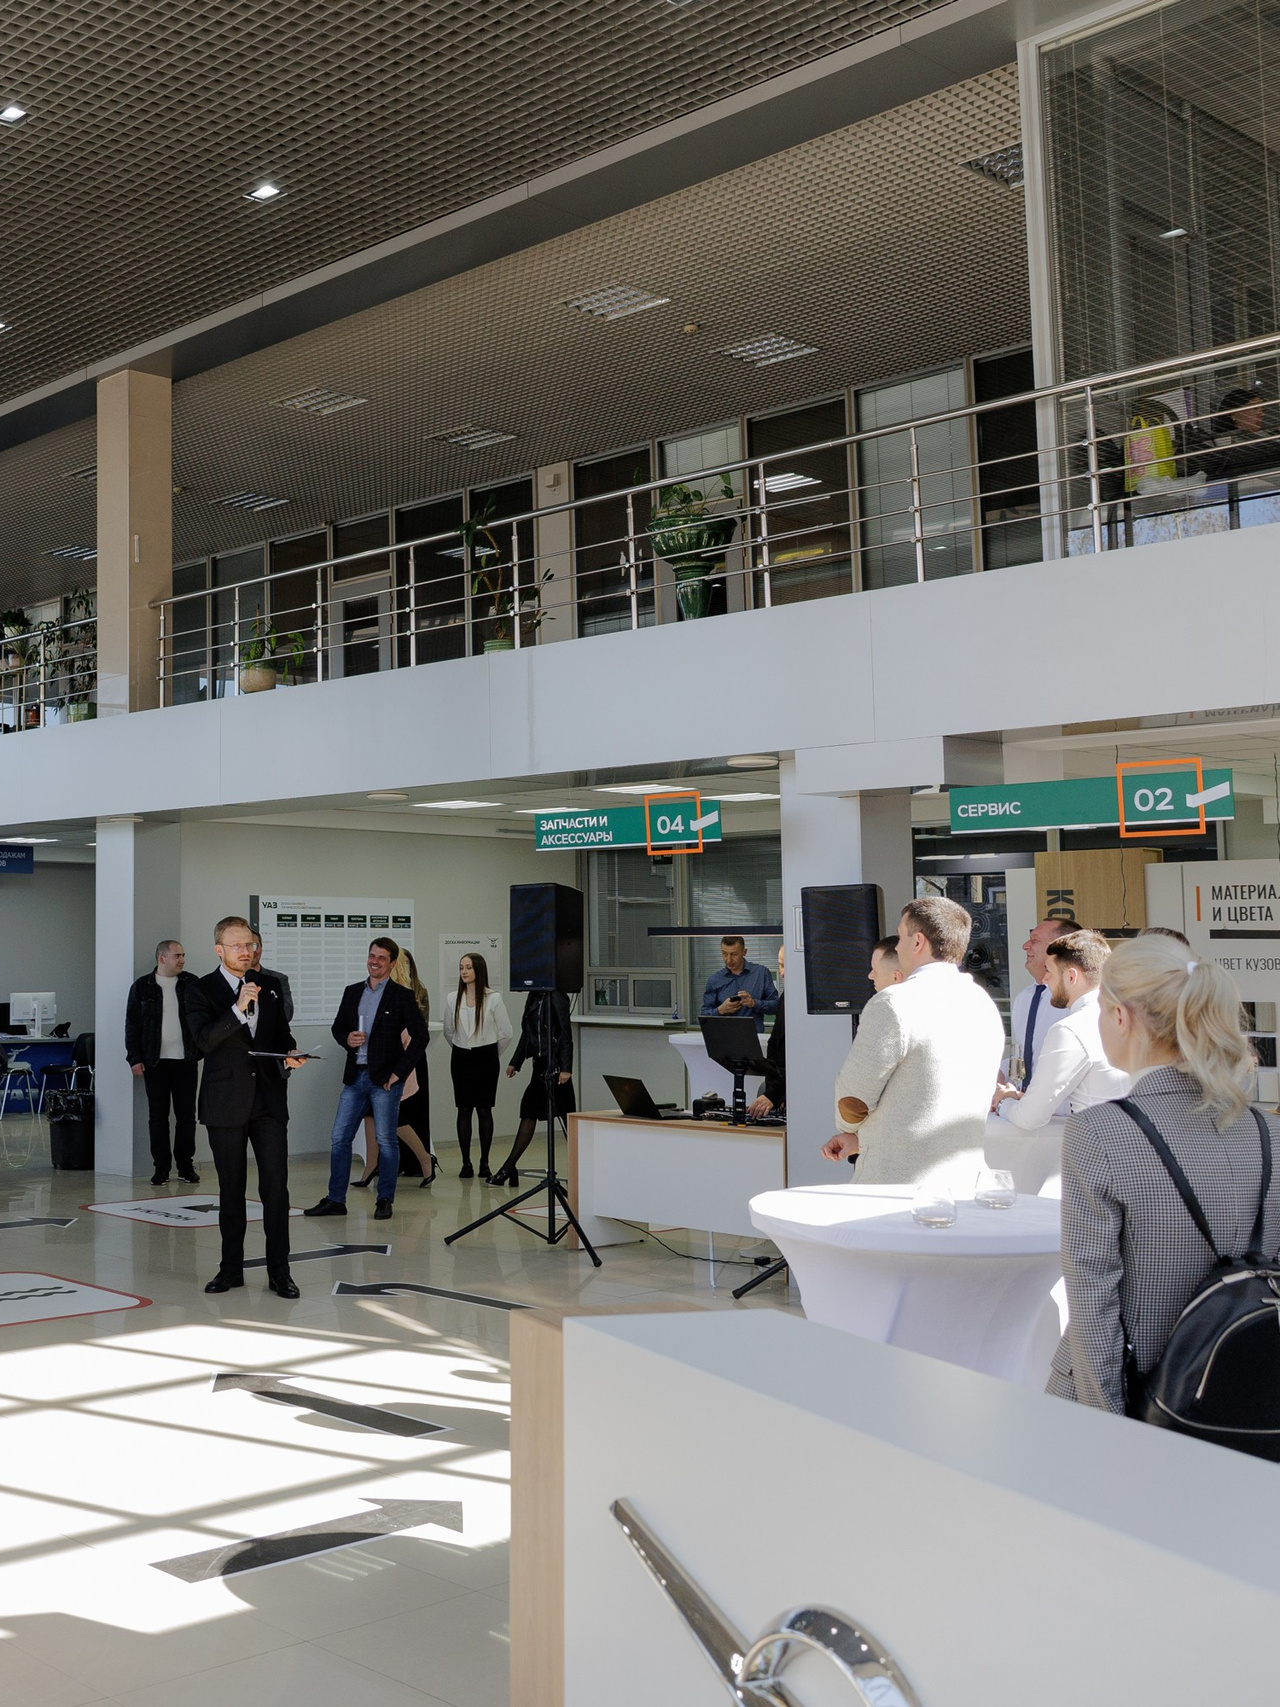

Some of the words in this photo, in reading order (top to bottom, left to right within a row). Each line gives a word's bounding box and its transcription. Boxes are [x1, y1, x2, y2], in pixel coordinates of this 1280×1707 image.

[1133, 787, 1175, 812] 02
[957, 801, 1022, 818] СЕРВИС
[539, 816, 598, 831] ЗАПЧАСТИ
[599, 815, 608, 827] И
[656, 814, 685, 835] 04
[540, 831, 613, 846] АКСЕССУАРЫ
[1211, 884, 1280, 901] МАТЕРИА
[261, 901, 278, 909] УАЗ
[1212, 906, 1222, 922] И
[1227, 905, 1274, 924] ЦВЕТА
